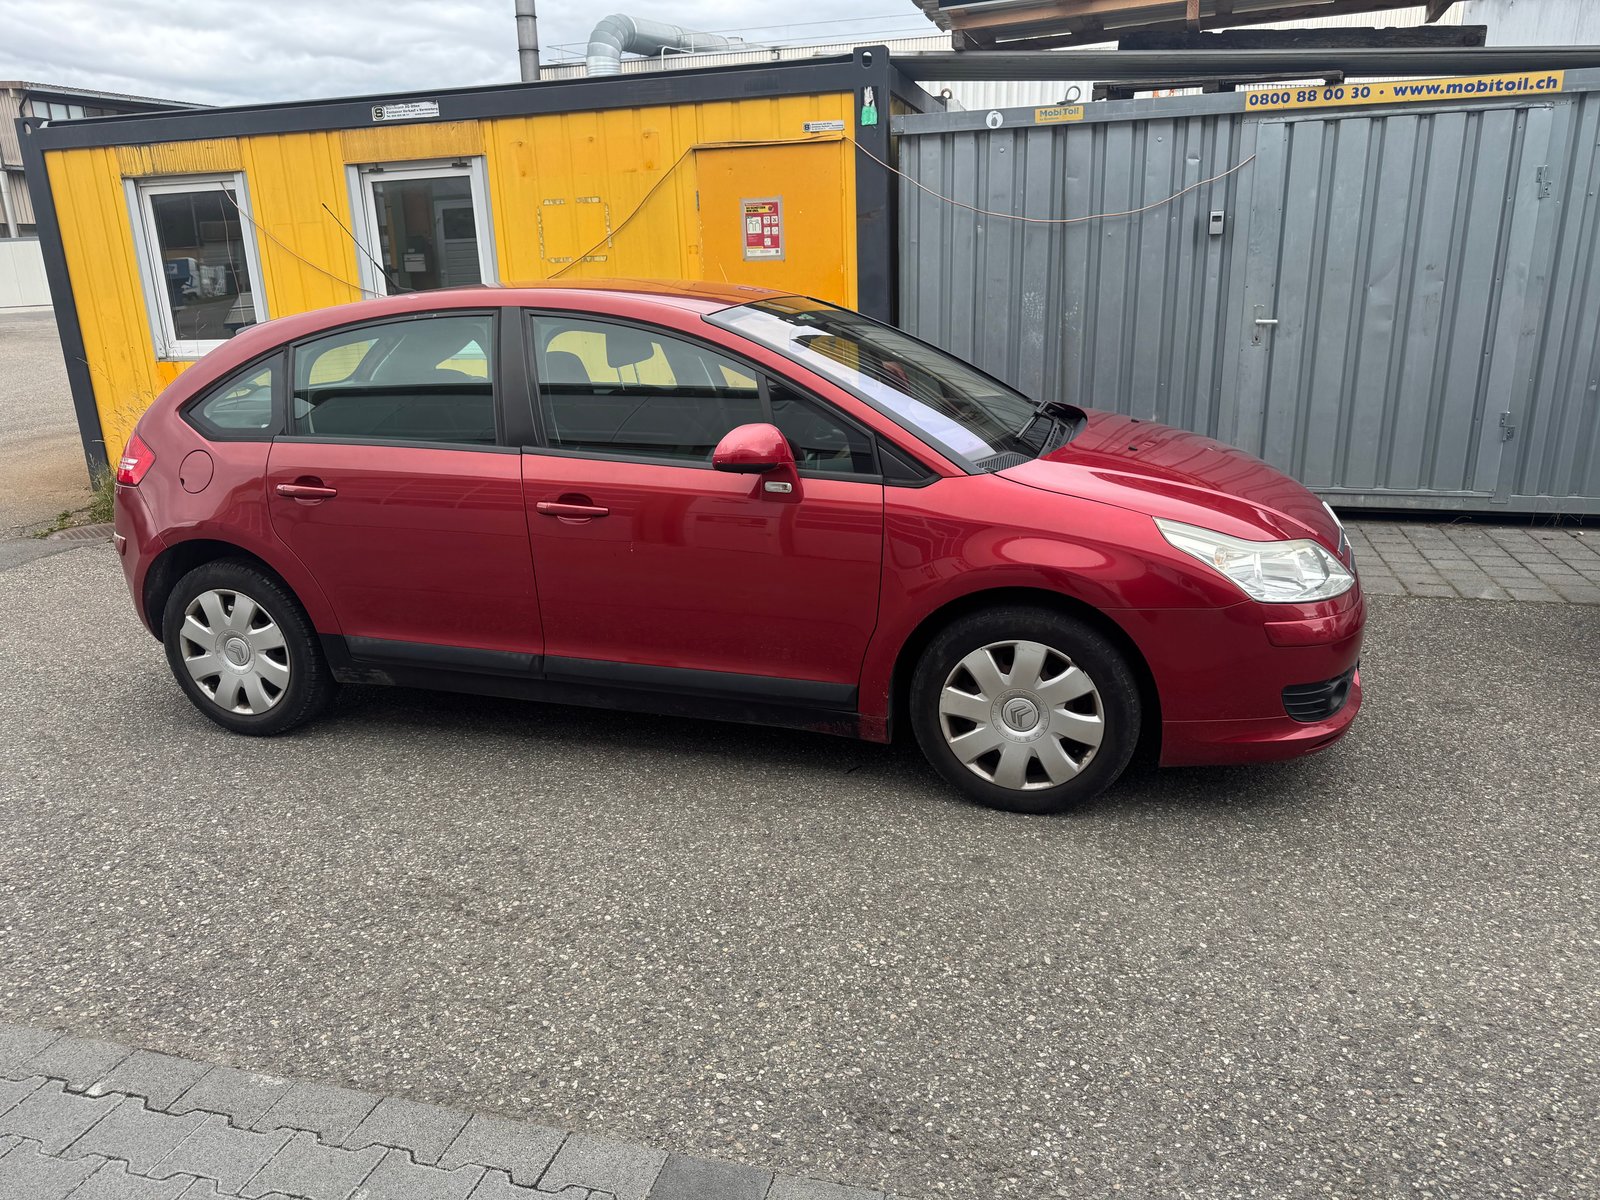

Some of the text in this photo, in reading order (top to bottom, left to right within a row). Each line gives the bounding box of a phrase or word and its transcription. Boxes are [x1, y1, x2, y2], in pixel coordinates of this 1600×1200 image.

[1249, 76, 1558, 106] 0800 88 00 30 www.mobitoil.ch
